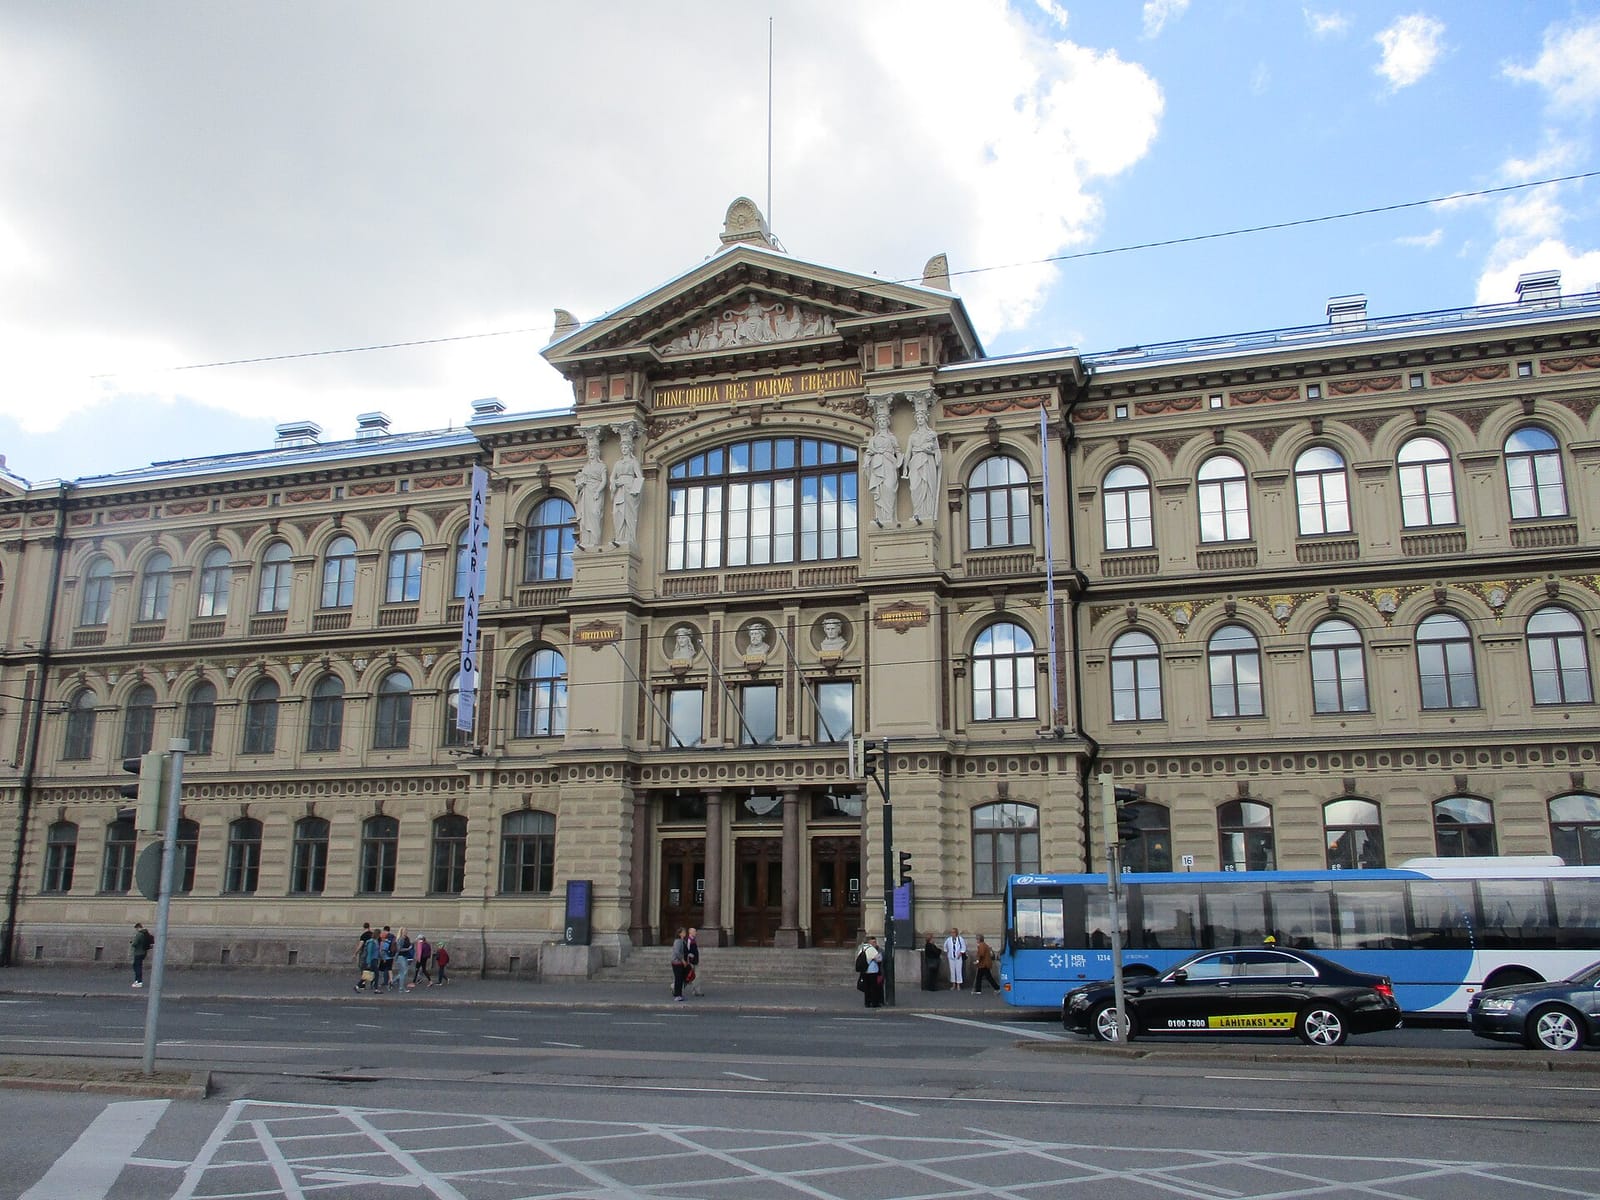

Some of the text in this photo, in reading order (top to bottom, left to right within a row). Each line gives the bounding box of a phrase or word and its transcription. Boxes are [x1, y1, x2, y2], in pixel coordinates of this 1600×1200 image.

[725, 382, 748, 400] RES
[463, 490, 482, 672] ALVAR AALTO
[1183, 856, 1193, 865] 16
[1167, 1019, 1206, 1028] 0100 7300
